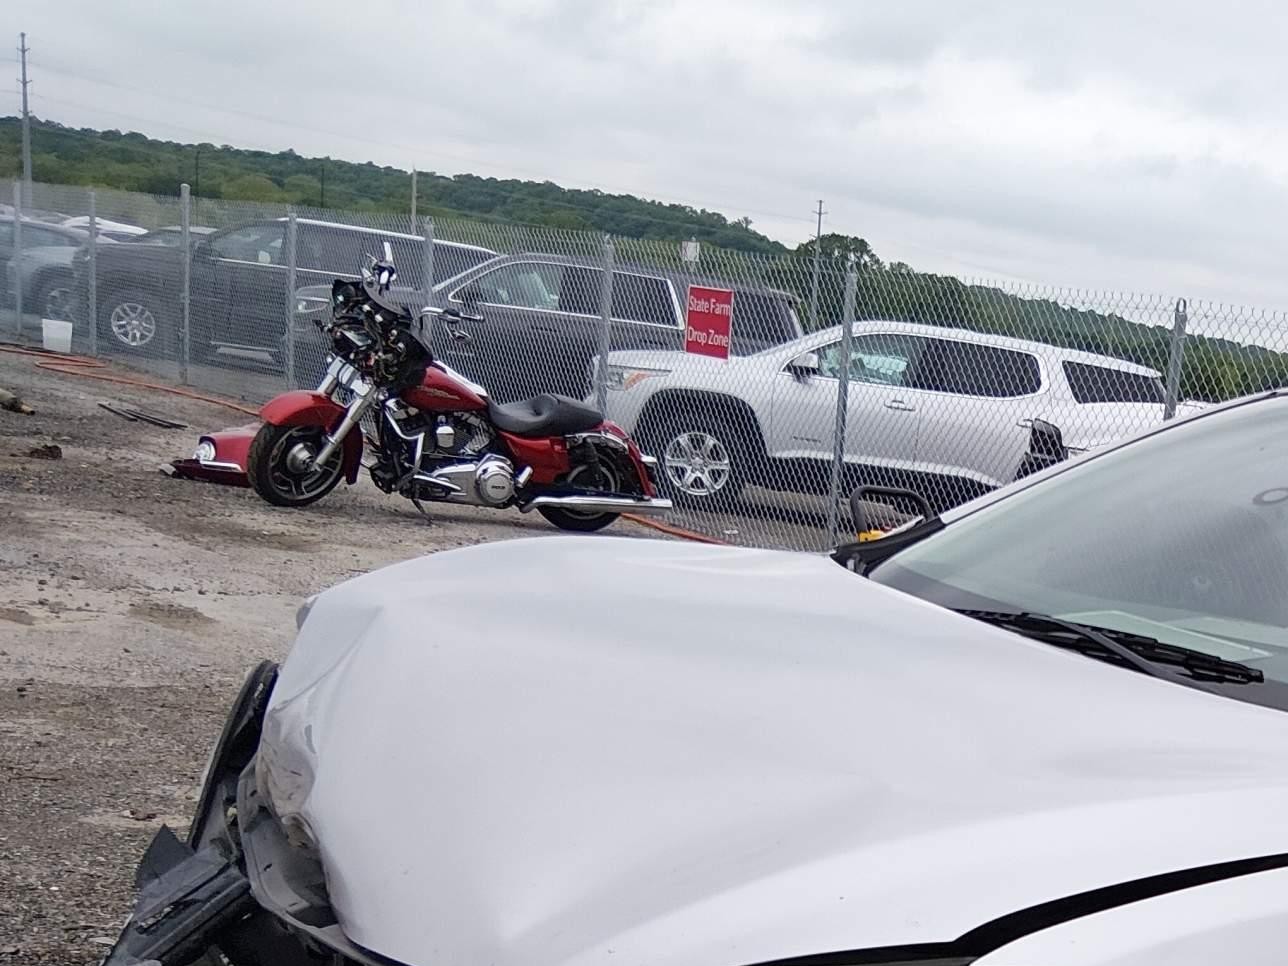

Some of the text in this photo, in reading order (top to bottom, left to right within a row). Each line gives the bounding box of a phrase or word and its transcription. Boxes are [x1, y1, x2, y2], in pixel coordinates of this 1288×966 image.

[688, 295, 731, 316] State Farm
[687, 326, 729, 347] Drop Zone
